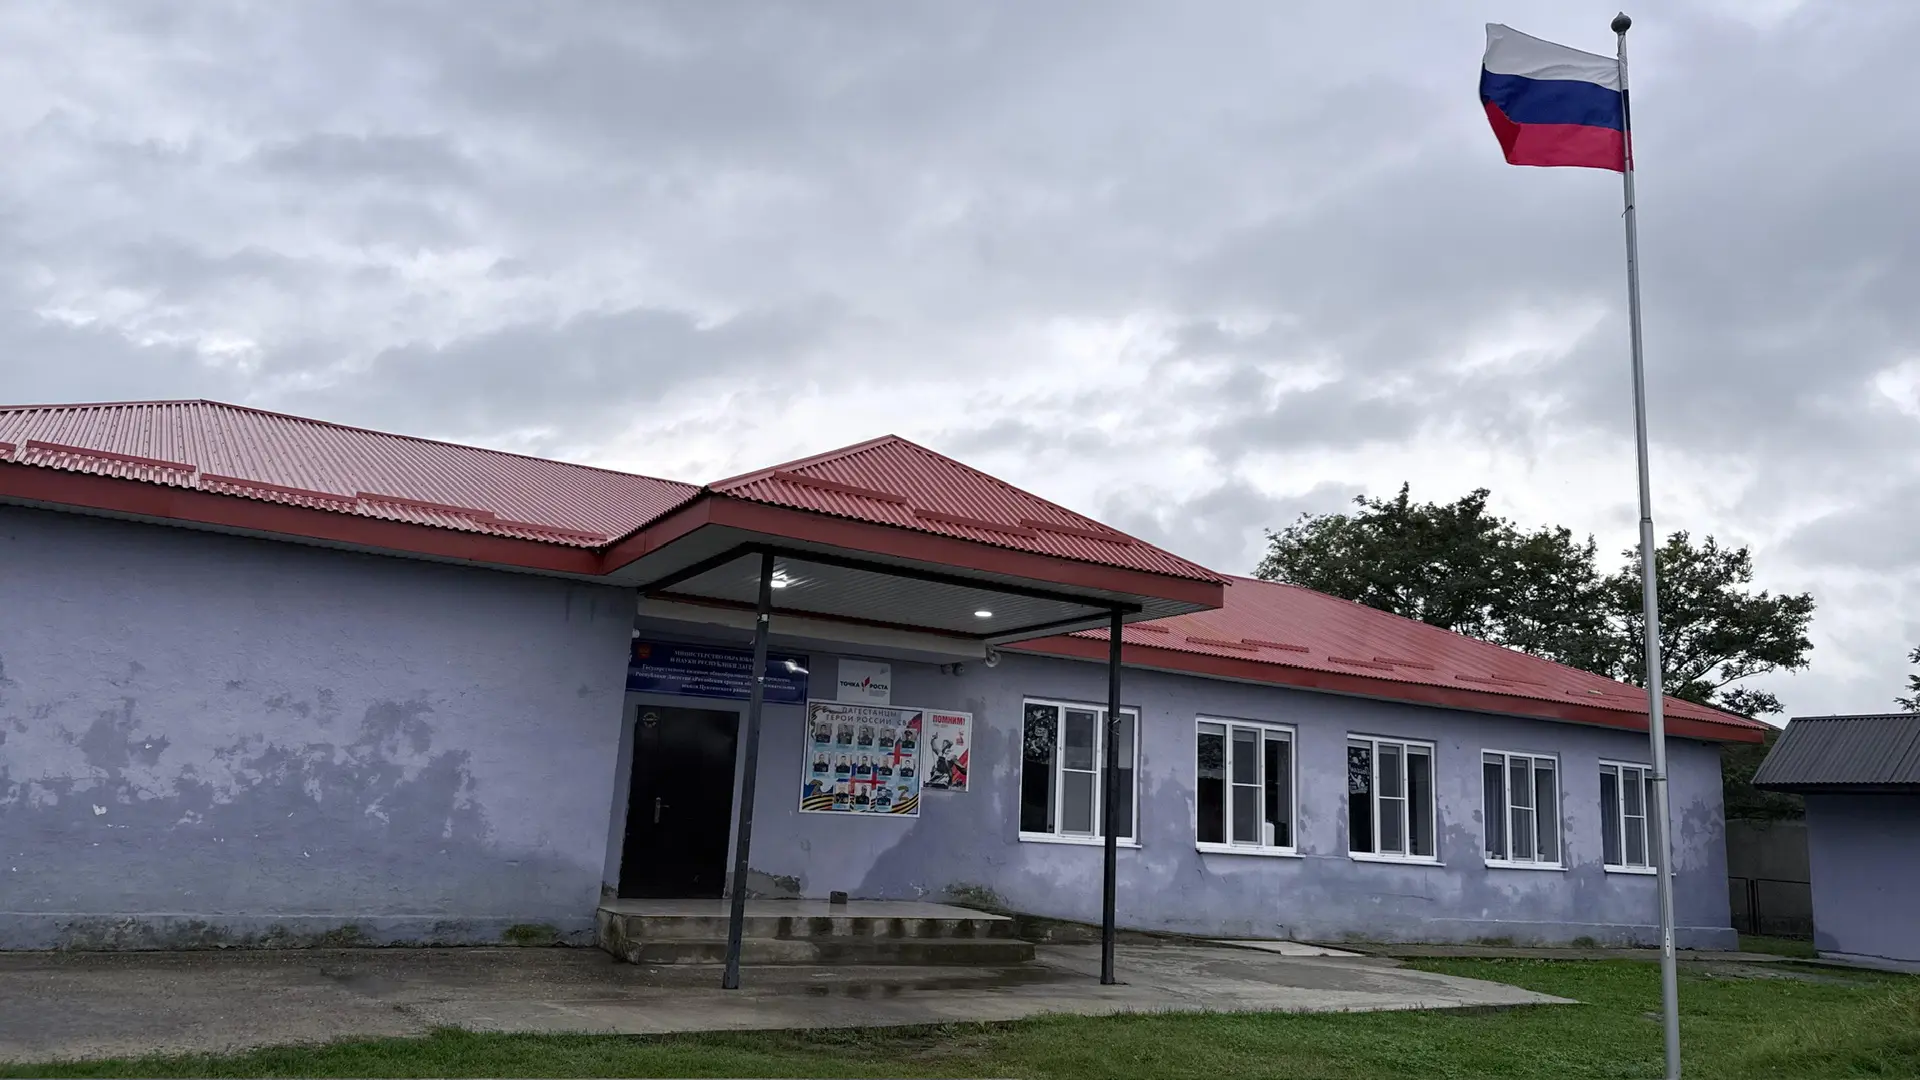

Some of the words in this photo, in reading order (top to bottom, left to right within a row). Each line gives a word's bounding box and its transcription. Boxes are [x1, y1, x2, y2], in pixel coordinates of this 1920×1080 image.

[840, 680, 860, 688] ТОЧКА
[842, 707, 897, 717] ДАГЕСТАНЦЫ
[826, 714, 853, 722] ГЕРОИ
[857, 717, 892, 725] РОССИИ
[933, 715, 966, 726] ПОМНИМ!
